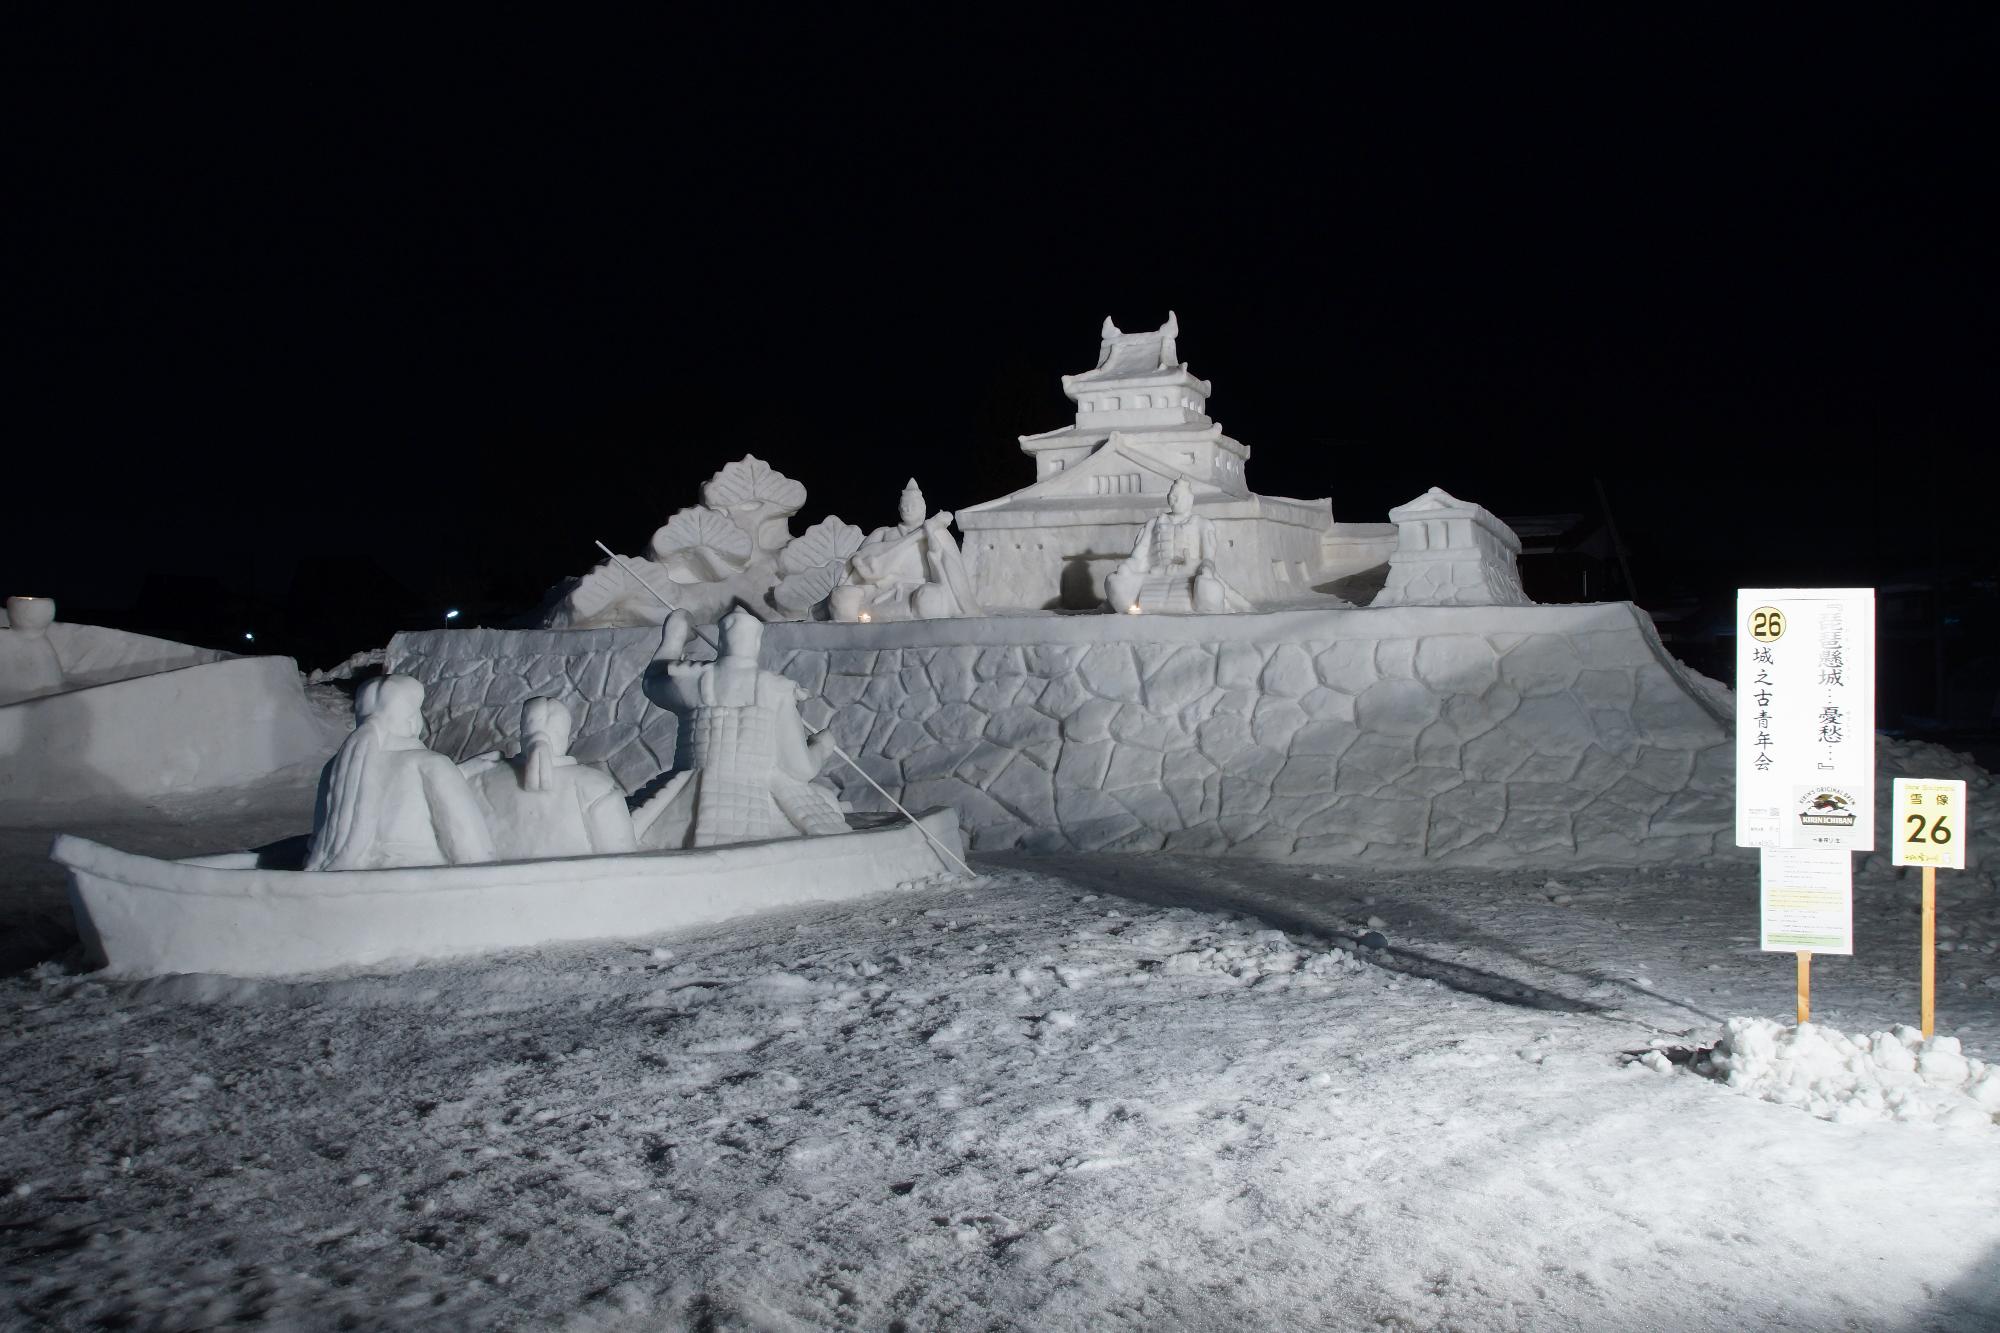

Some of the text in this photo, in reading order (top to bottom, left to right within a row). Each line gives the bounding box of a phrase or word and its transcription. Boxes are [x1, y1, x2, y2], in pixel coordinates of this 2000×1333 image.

[1753, 612, 1781, 637] 26
[1752, 646, 1774, 771] 城之古青年会
[1910, 793, 1949, 806] 雪像
[1802, 816, 1853, 825] KIRIN ICHIBAN
[1907, 814, 1951, 845] 26
